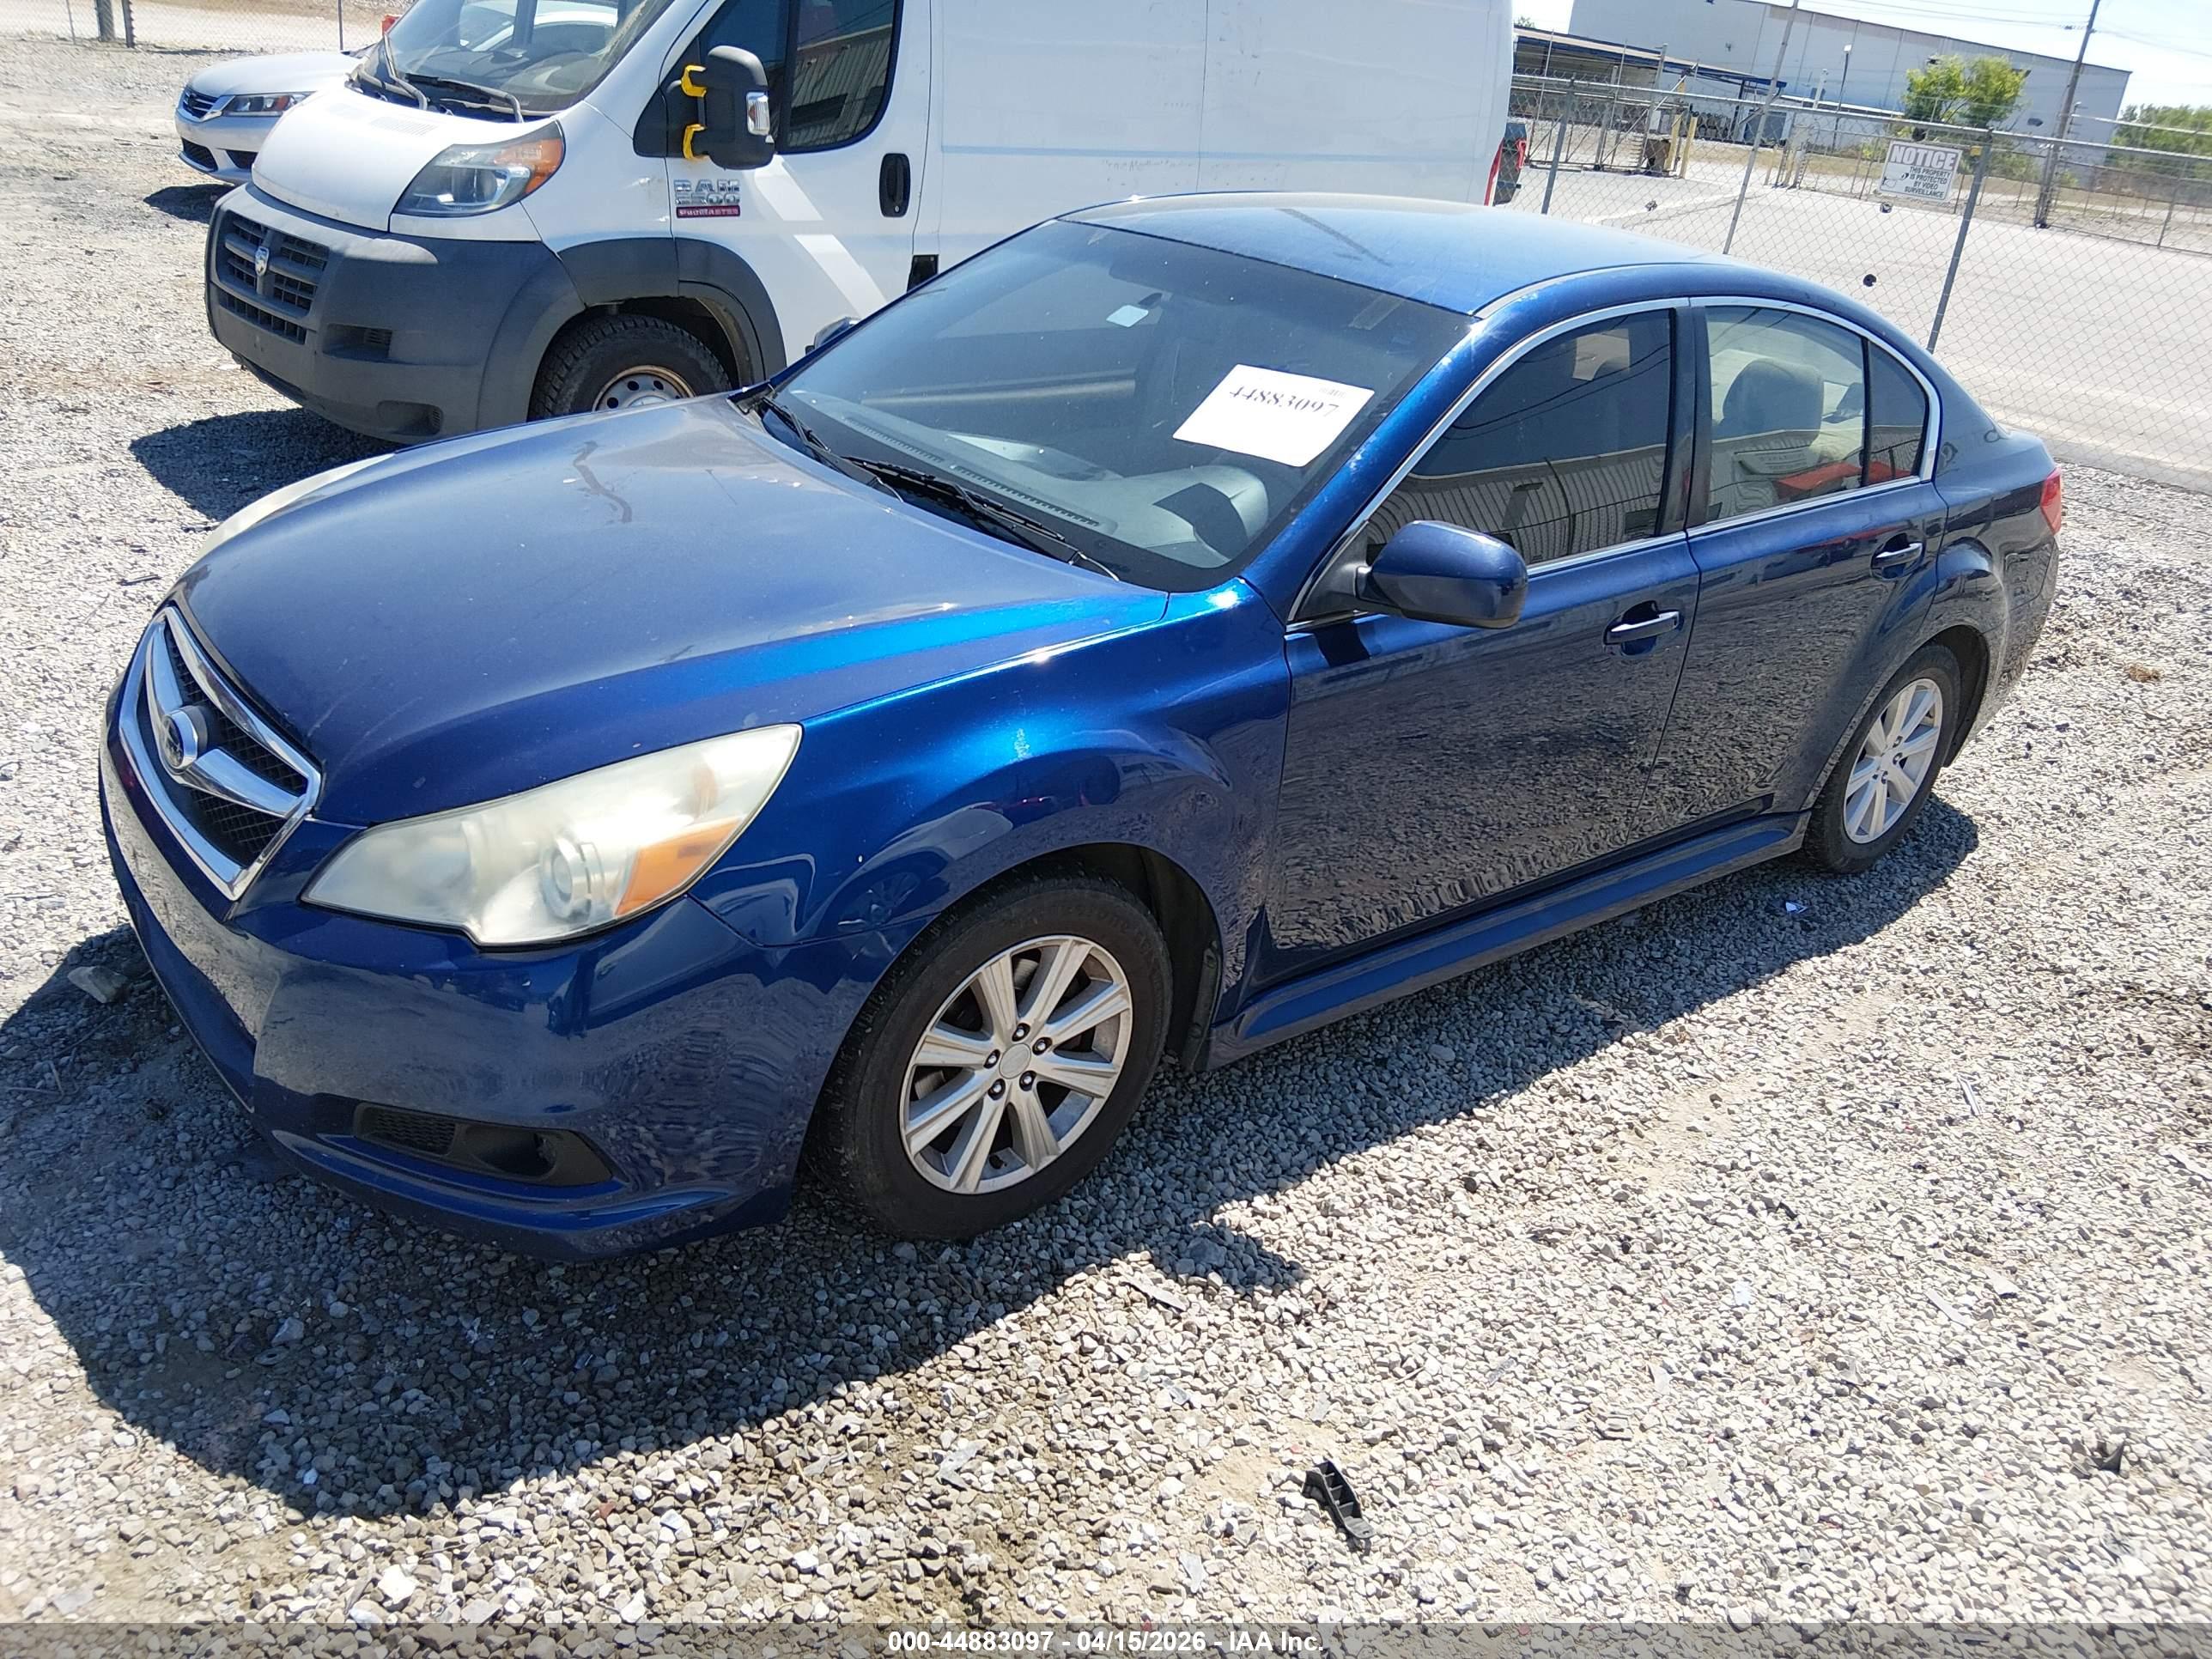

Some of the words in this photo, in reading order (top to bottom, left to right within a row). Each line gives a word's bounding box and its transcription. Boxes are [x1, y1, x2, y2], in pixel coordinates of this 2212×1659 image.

[1891, 145, 1956, 170] NOTICE
[1909, 166, 1921, 174] THIS
[1922, 167, 1951, 179] PROPERTY
[1916, 173, 1948, 185] PROTECTED
[673, 179, 740, 192] RAM
[1904, 185, 1944, 198] SURVEILLANCE
[1229, 386, 1340, 417] 44883097
